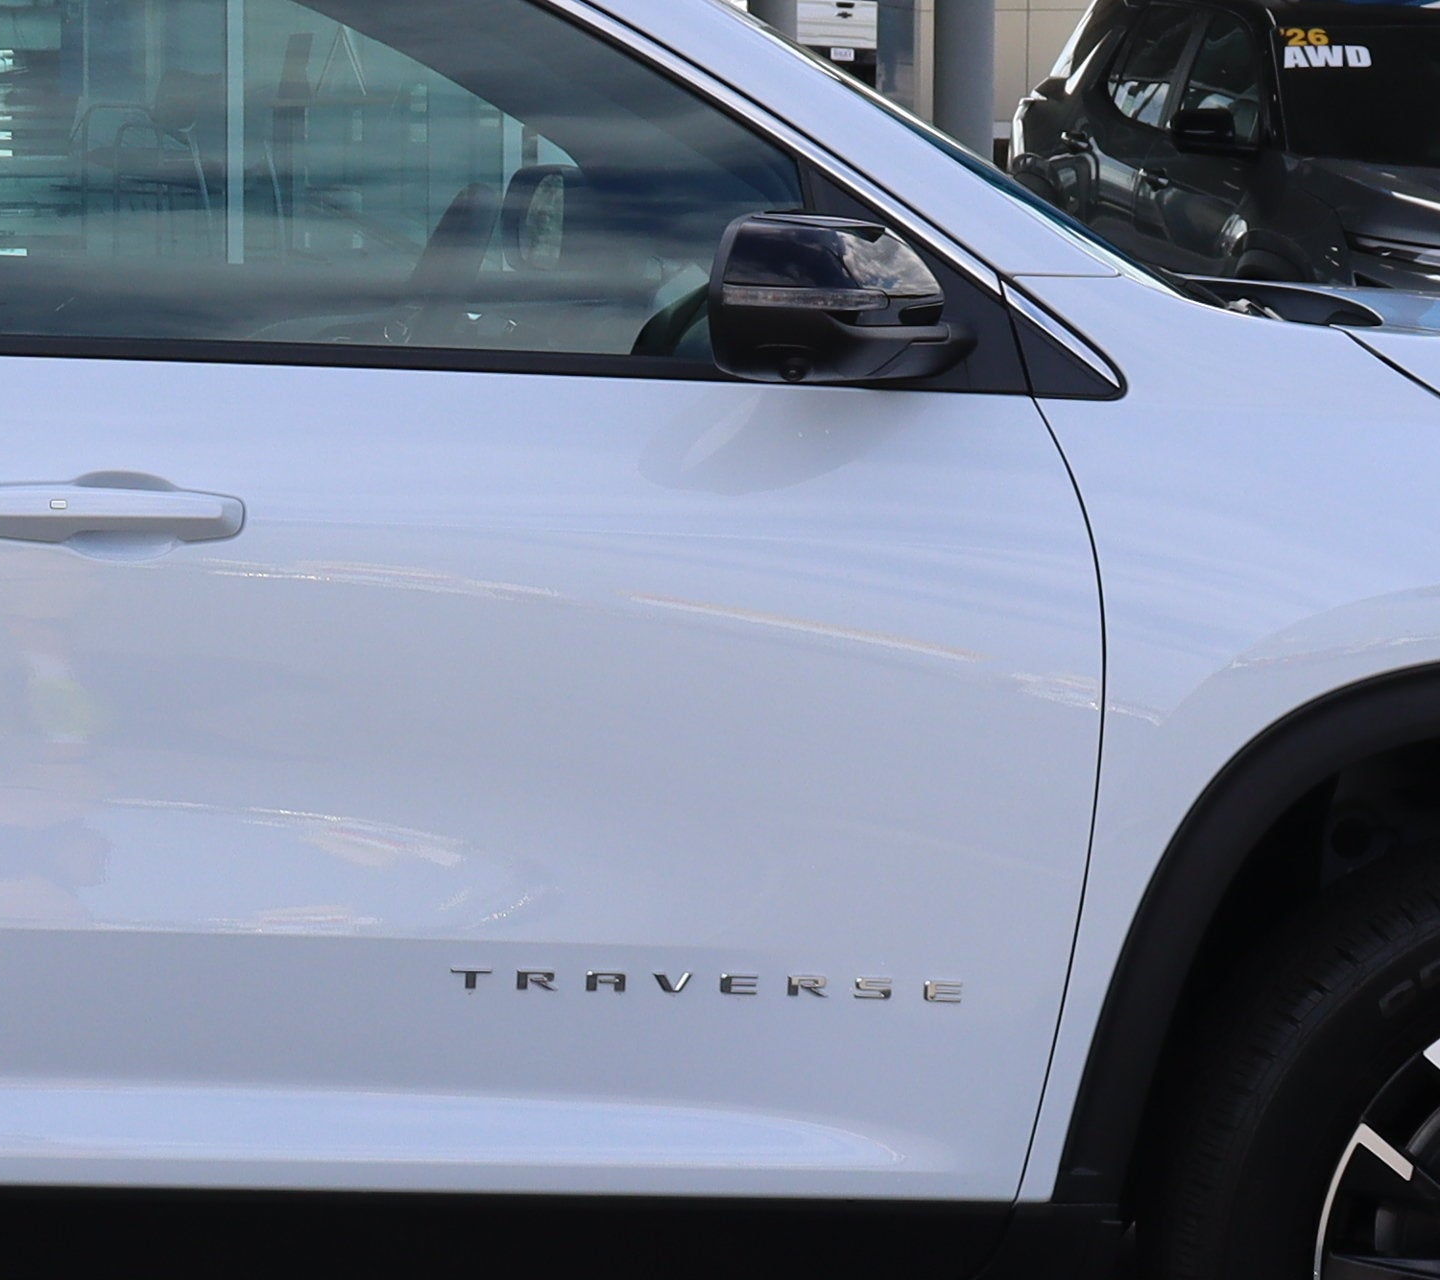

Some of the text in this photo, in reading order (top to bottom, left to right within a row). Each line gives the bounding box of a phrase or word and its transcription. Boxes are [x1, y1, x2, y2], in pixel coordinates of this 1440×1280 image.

[1279, 28, 1329, 47] '26
[1283, 45, 1372, 69] AWD
[449, 966, 963, 1004] TRAVERSE
